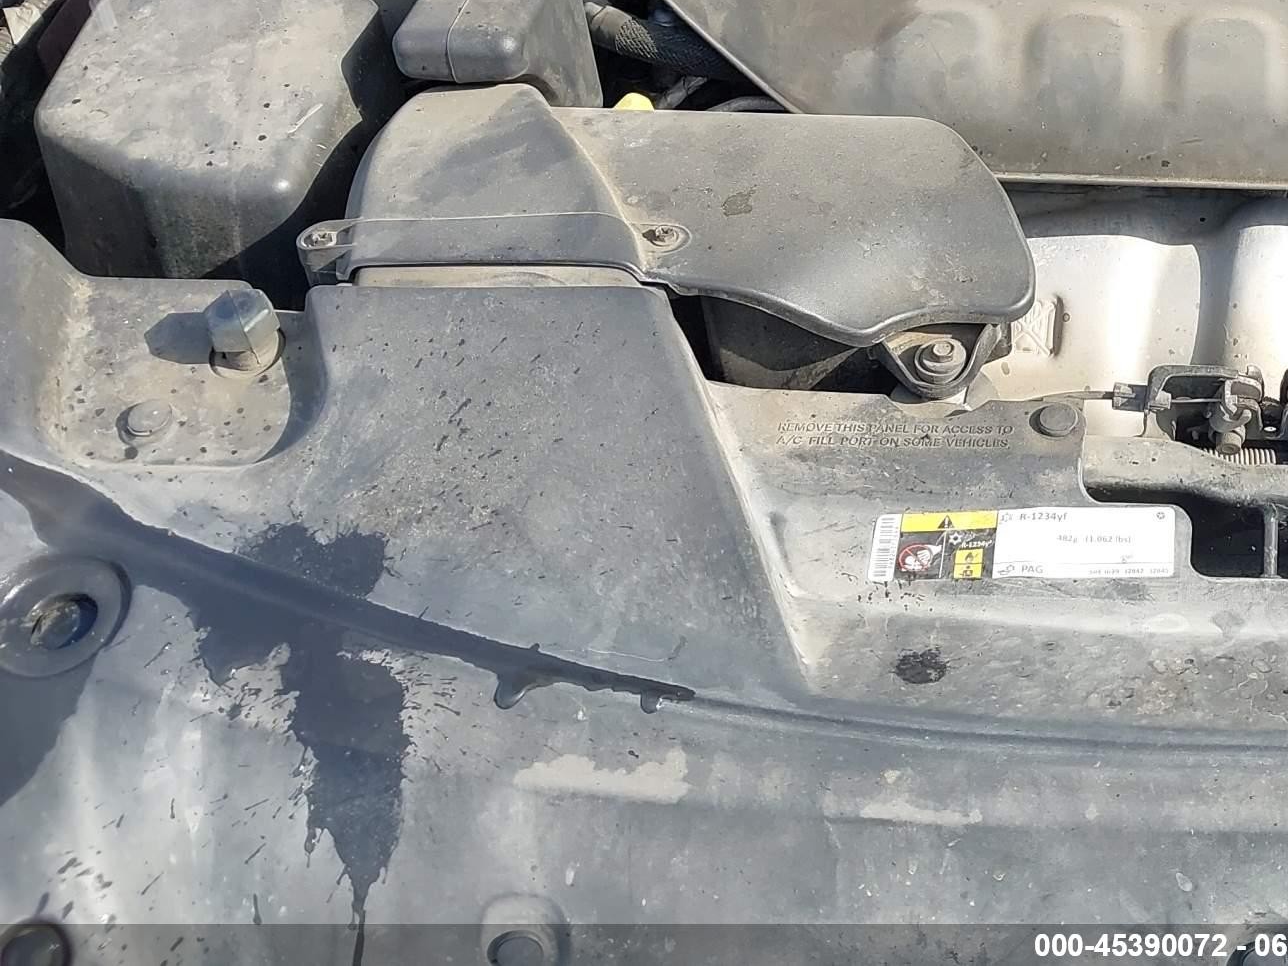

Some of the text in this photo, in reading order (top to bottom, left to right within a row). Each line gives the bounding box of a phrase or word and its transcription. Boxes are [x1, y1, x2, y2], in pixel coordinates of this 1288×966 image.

[777, 422, 1014, 435] REMOVE THIS PANEL FOR ACCESS TO
[776, 434, 803, 445] A/C
[809, 435, 836, 446] FILL
[840, 436, 876, 446] PORT
[879, 436, 900, 447] ON
[903, 436, 944, 448] SOME
[1019, 512, 1068, 523] R-1234yf
[1021, 564, 1044, 575] PAG
